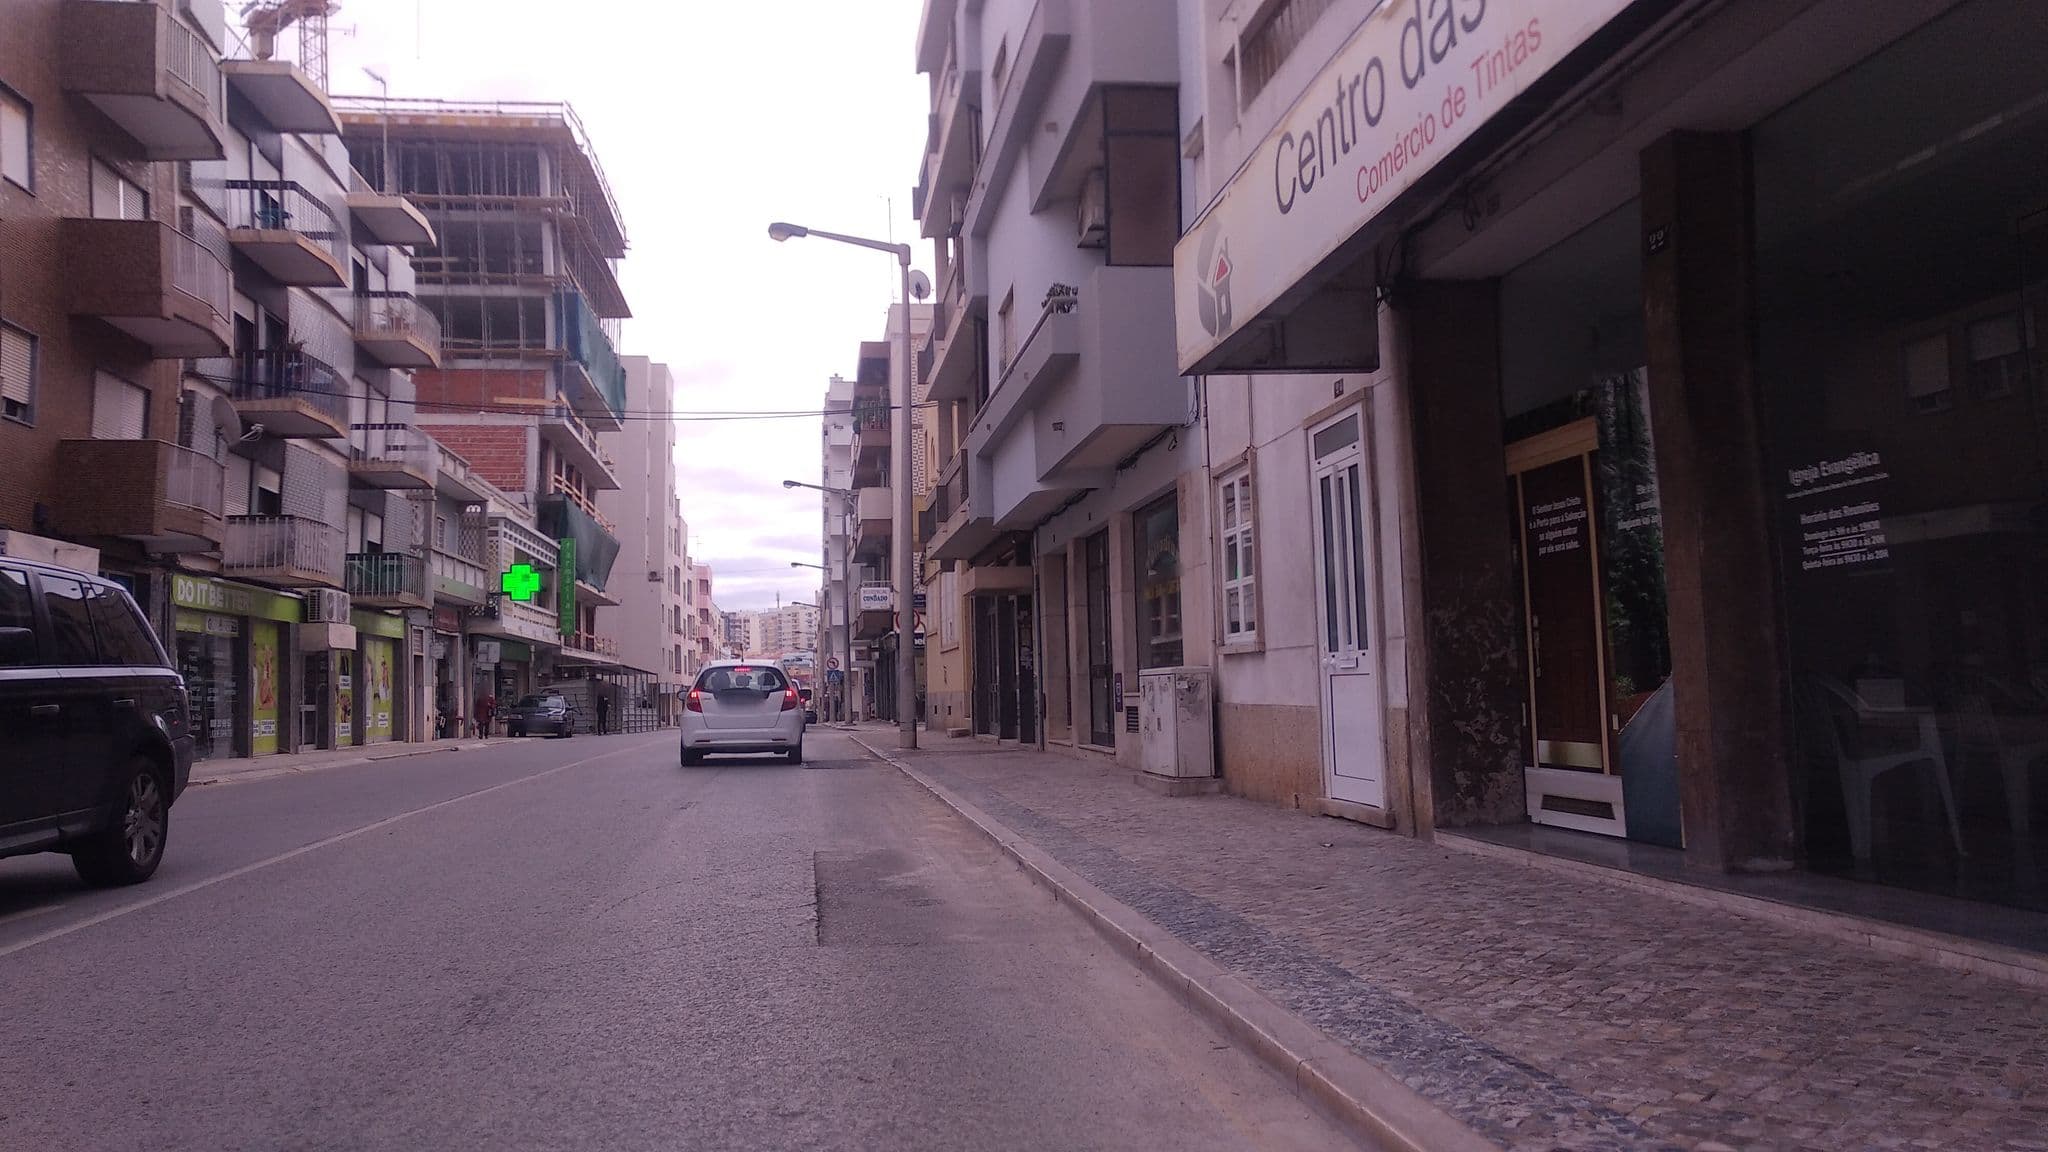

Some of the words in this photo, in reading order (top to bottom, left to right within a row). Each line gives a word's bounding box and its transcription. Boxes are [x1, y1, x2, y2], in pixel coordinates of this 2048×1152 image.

[1356, 111, 1435, 204] Comércio
[1441, 86, 1466, 129] de
[1470, 18, 1541, 99] Tintas
[1275, 56, 1385, 215] Centro
[1789, 465, 1820, 487] Igreja
[1820, 452, 1880, 476] Evangélica
[177, 577, 195, 603] DO
[197, 582, 208, 605] IT
[863, 594, 889, 603] CONDADO
